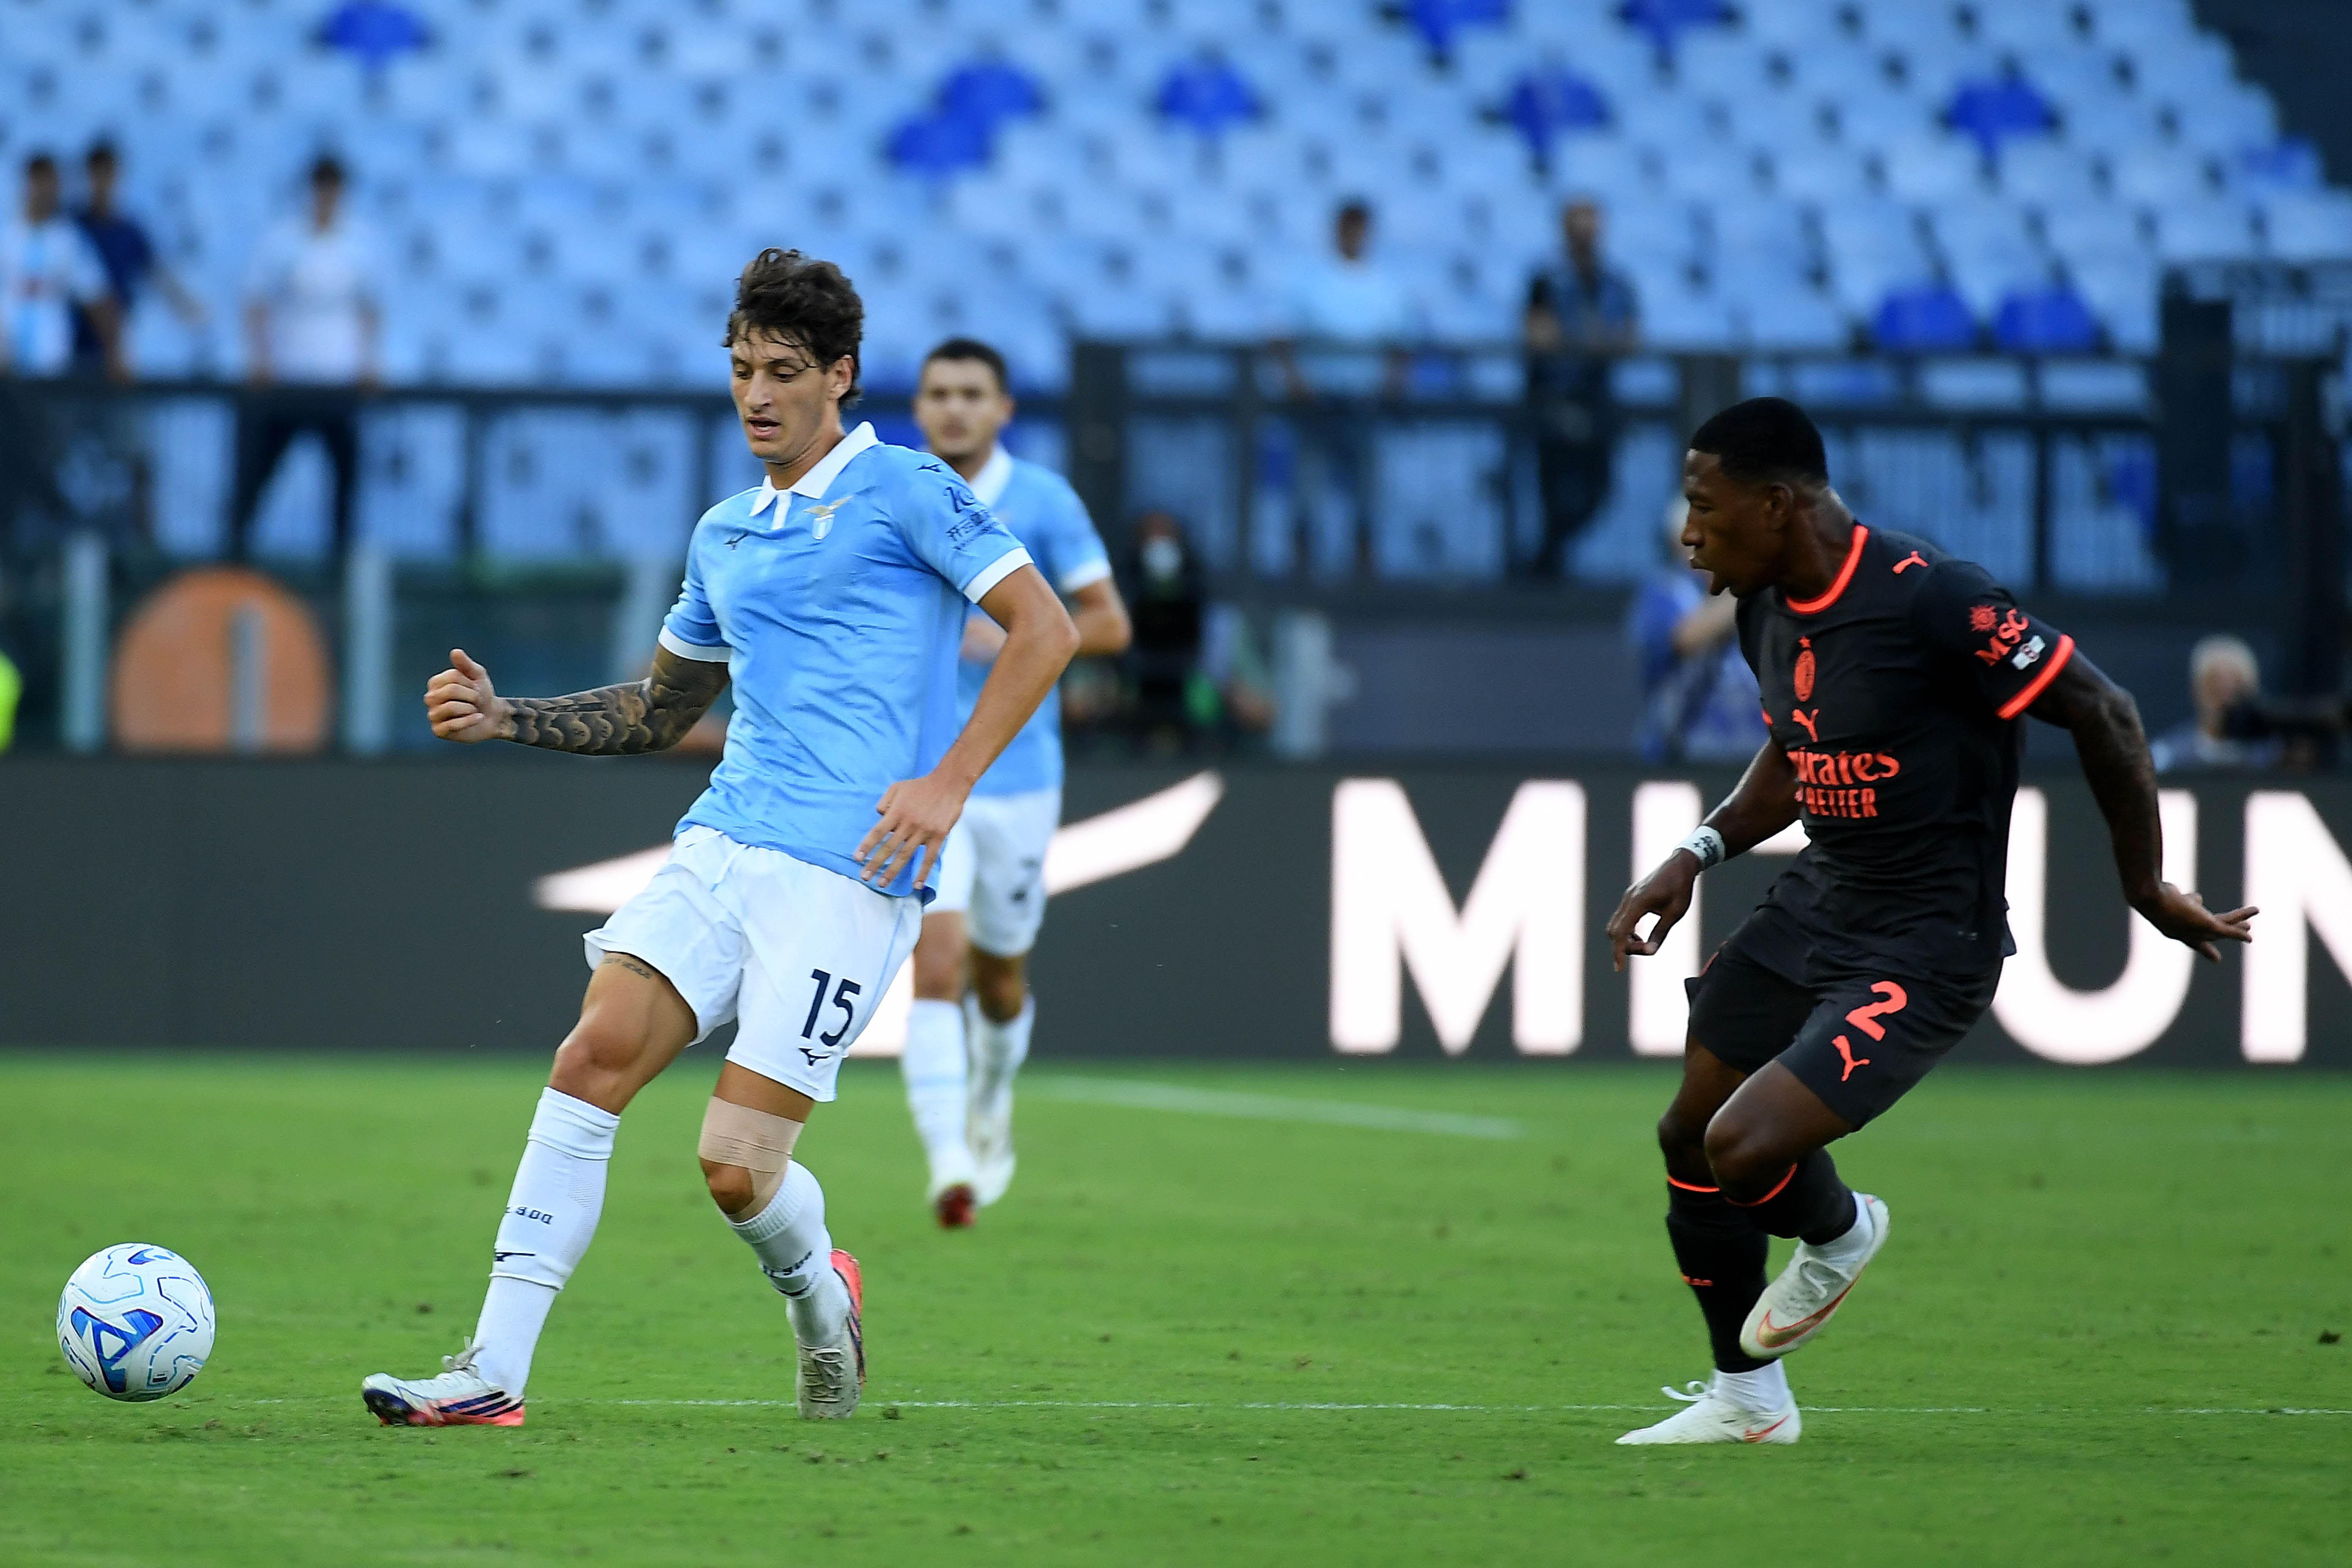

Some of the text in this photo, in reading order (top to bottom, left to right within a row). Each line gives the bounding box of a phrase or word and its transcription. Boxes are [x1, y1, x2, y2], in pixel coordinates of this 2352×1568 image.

[1974, 608, 2029, 667] MSC
[1786, 746, 1901, 786] irates
[1328, 778, 2352, 1064] MIUN
[801, 968, 861, 1047] 15
[1845, 980, 1908, 1042] 2
